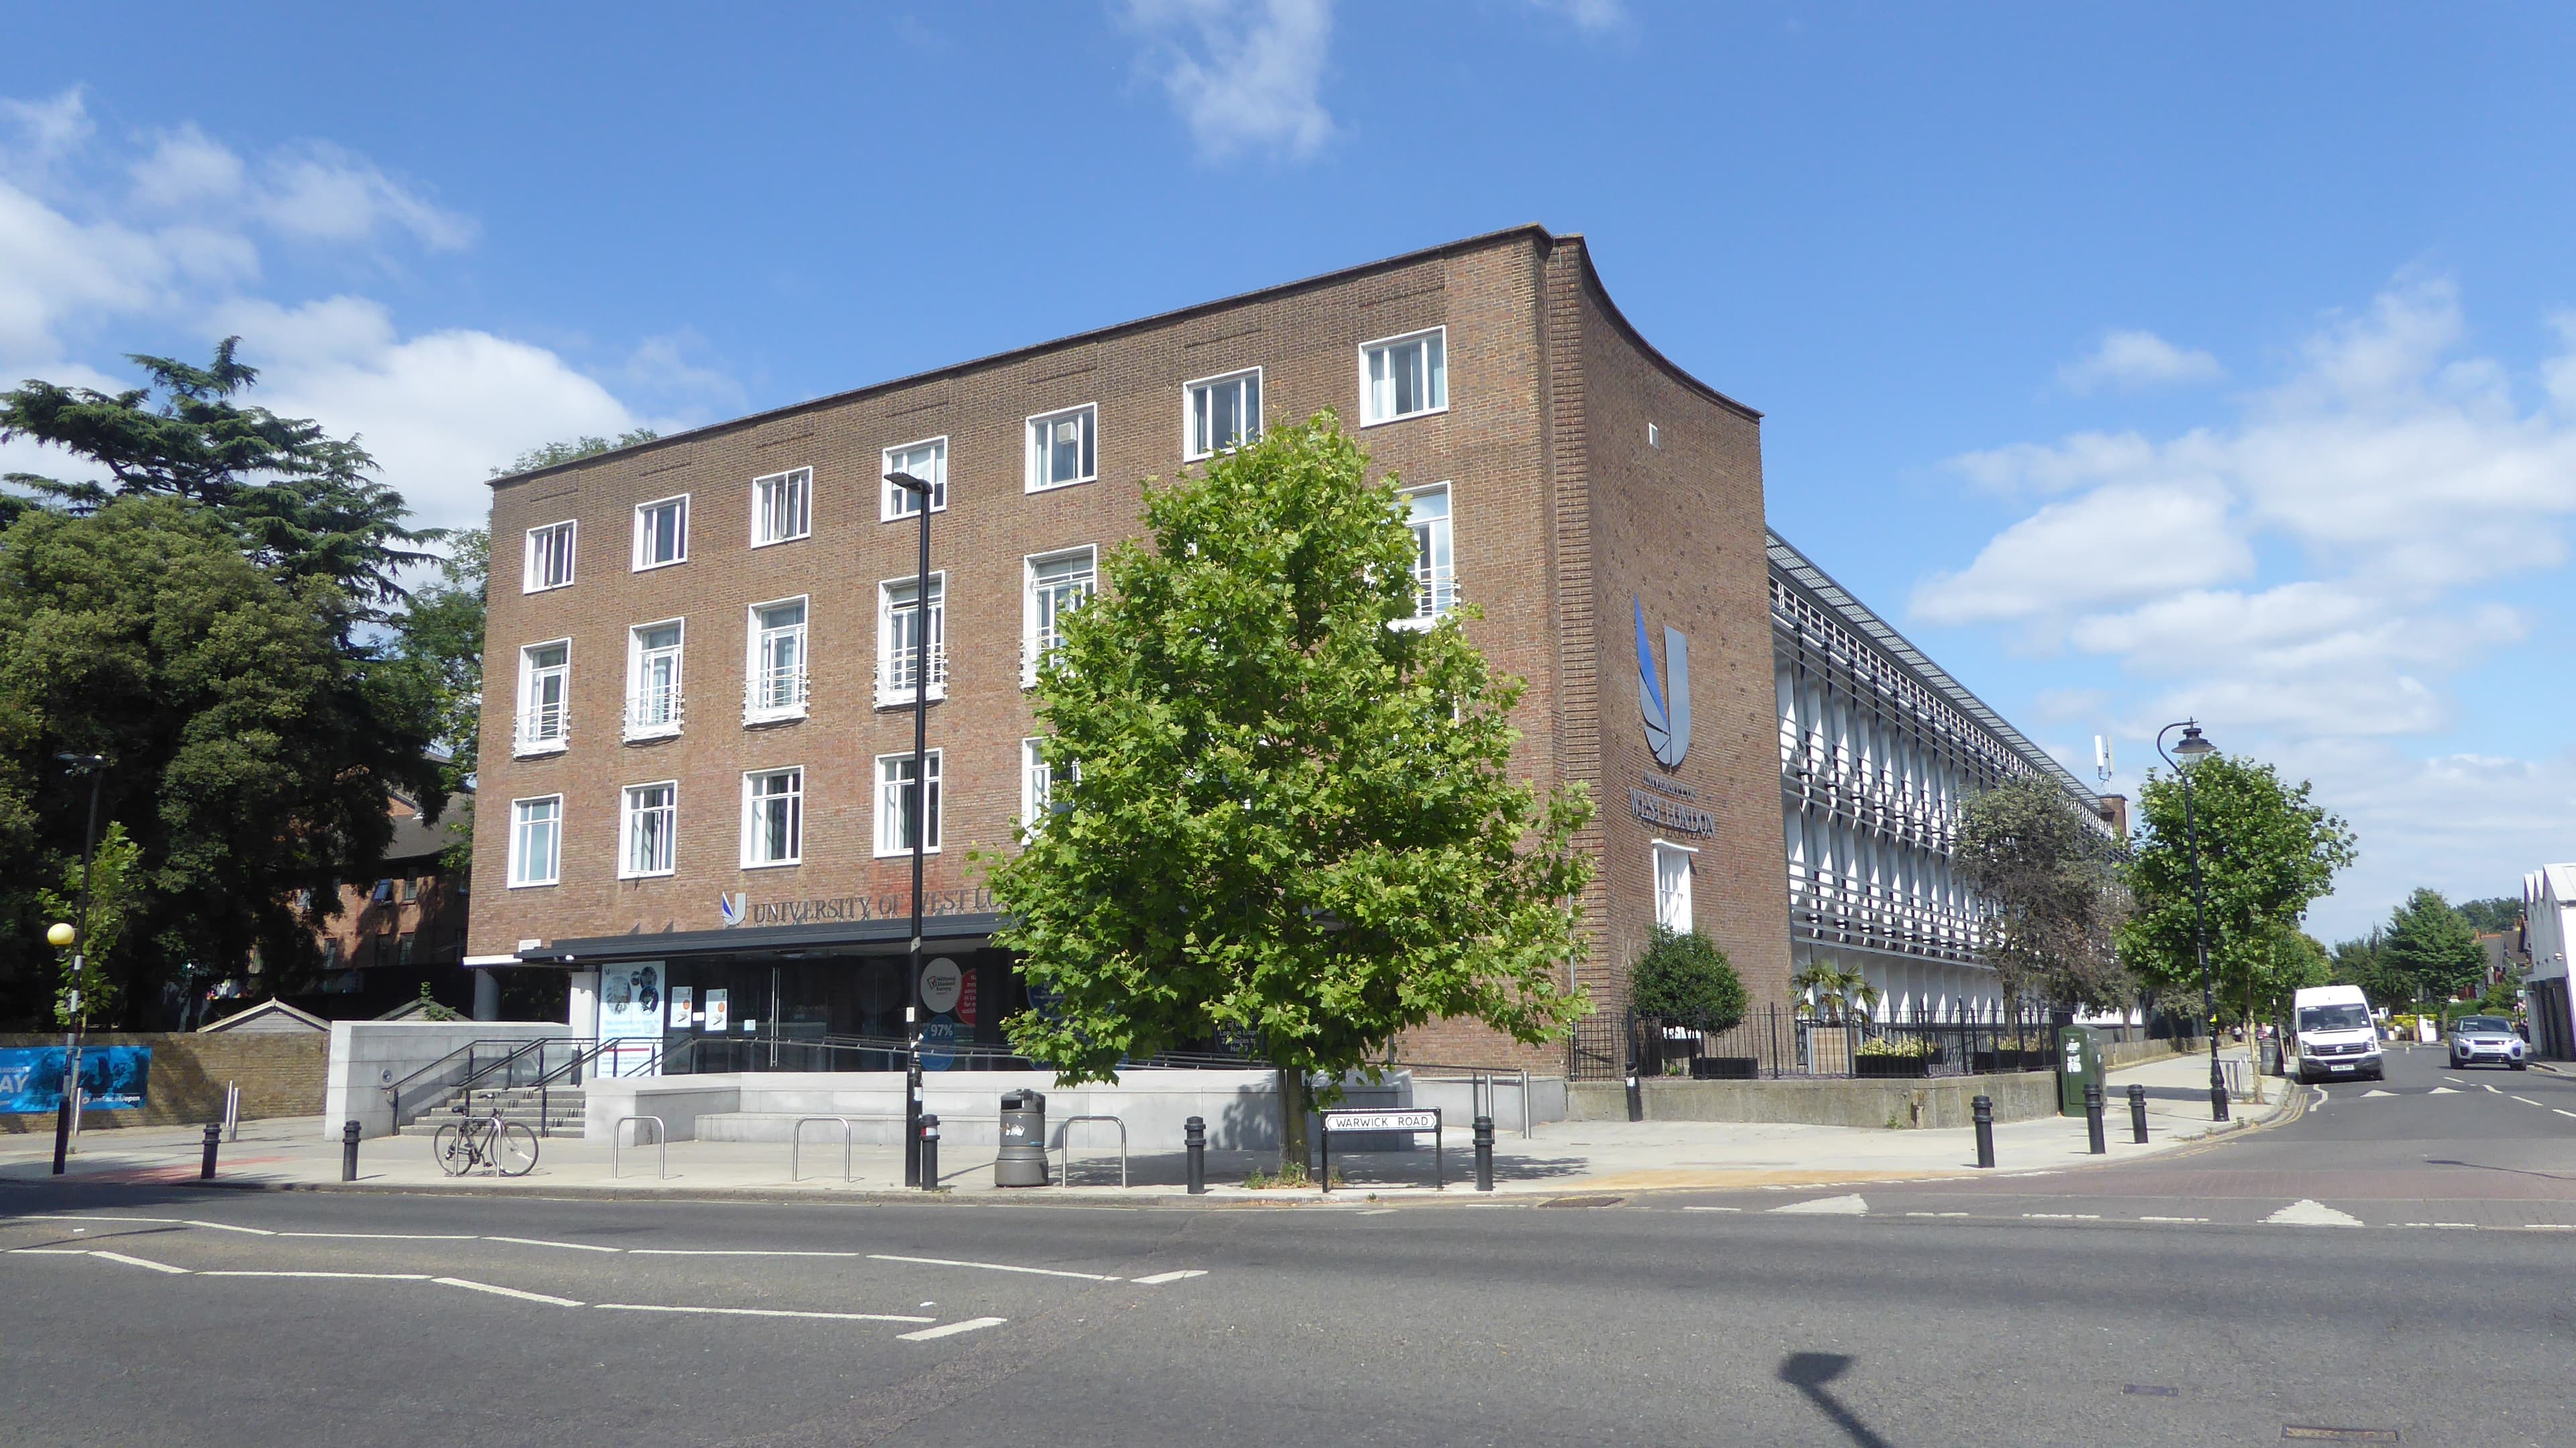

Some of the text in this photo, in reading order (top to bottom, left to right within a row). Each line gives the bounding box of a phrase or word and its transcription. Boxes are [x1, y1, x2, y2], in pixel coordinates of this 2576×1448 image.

[1629, 786, 1716, 838] WEST LONDON
[753, 896, 872, 923] UNIVERSITY
[879, 893, 904, 915] OF
[930, 1024, 953, 1037] 97%
[1336, 1116, 1429, 1128] WARWICK ROAD
